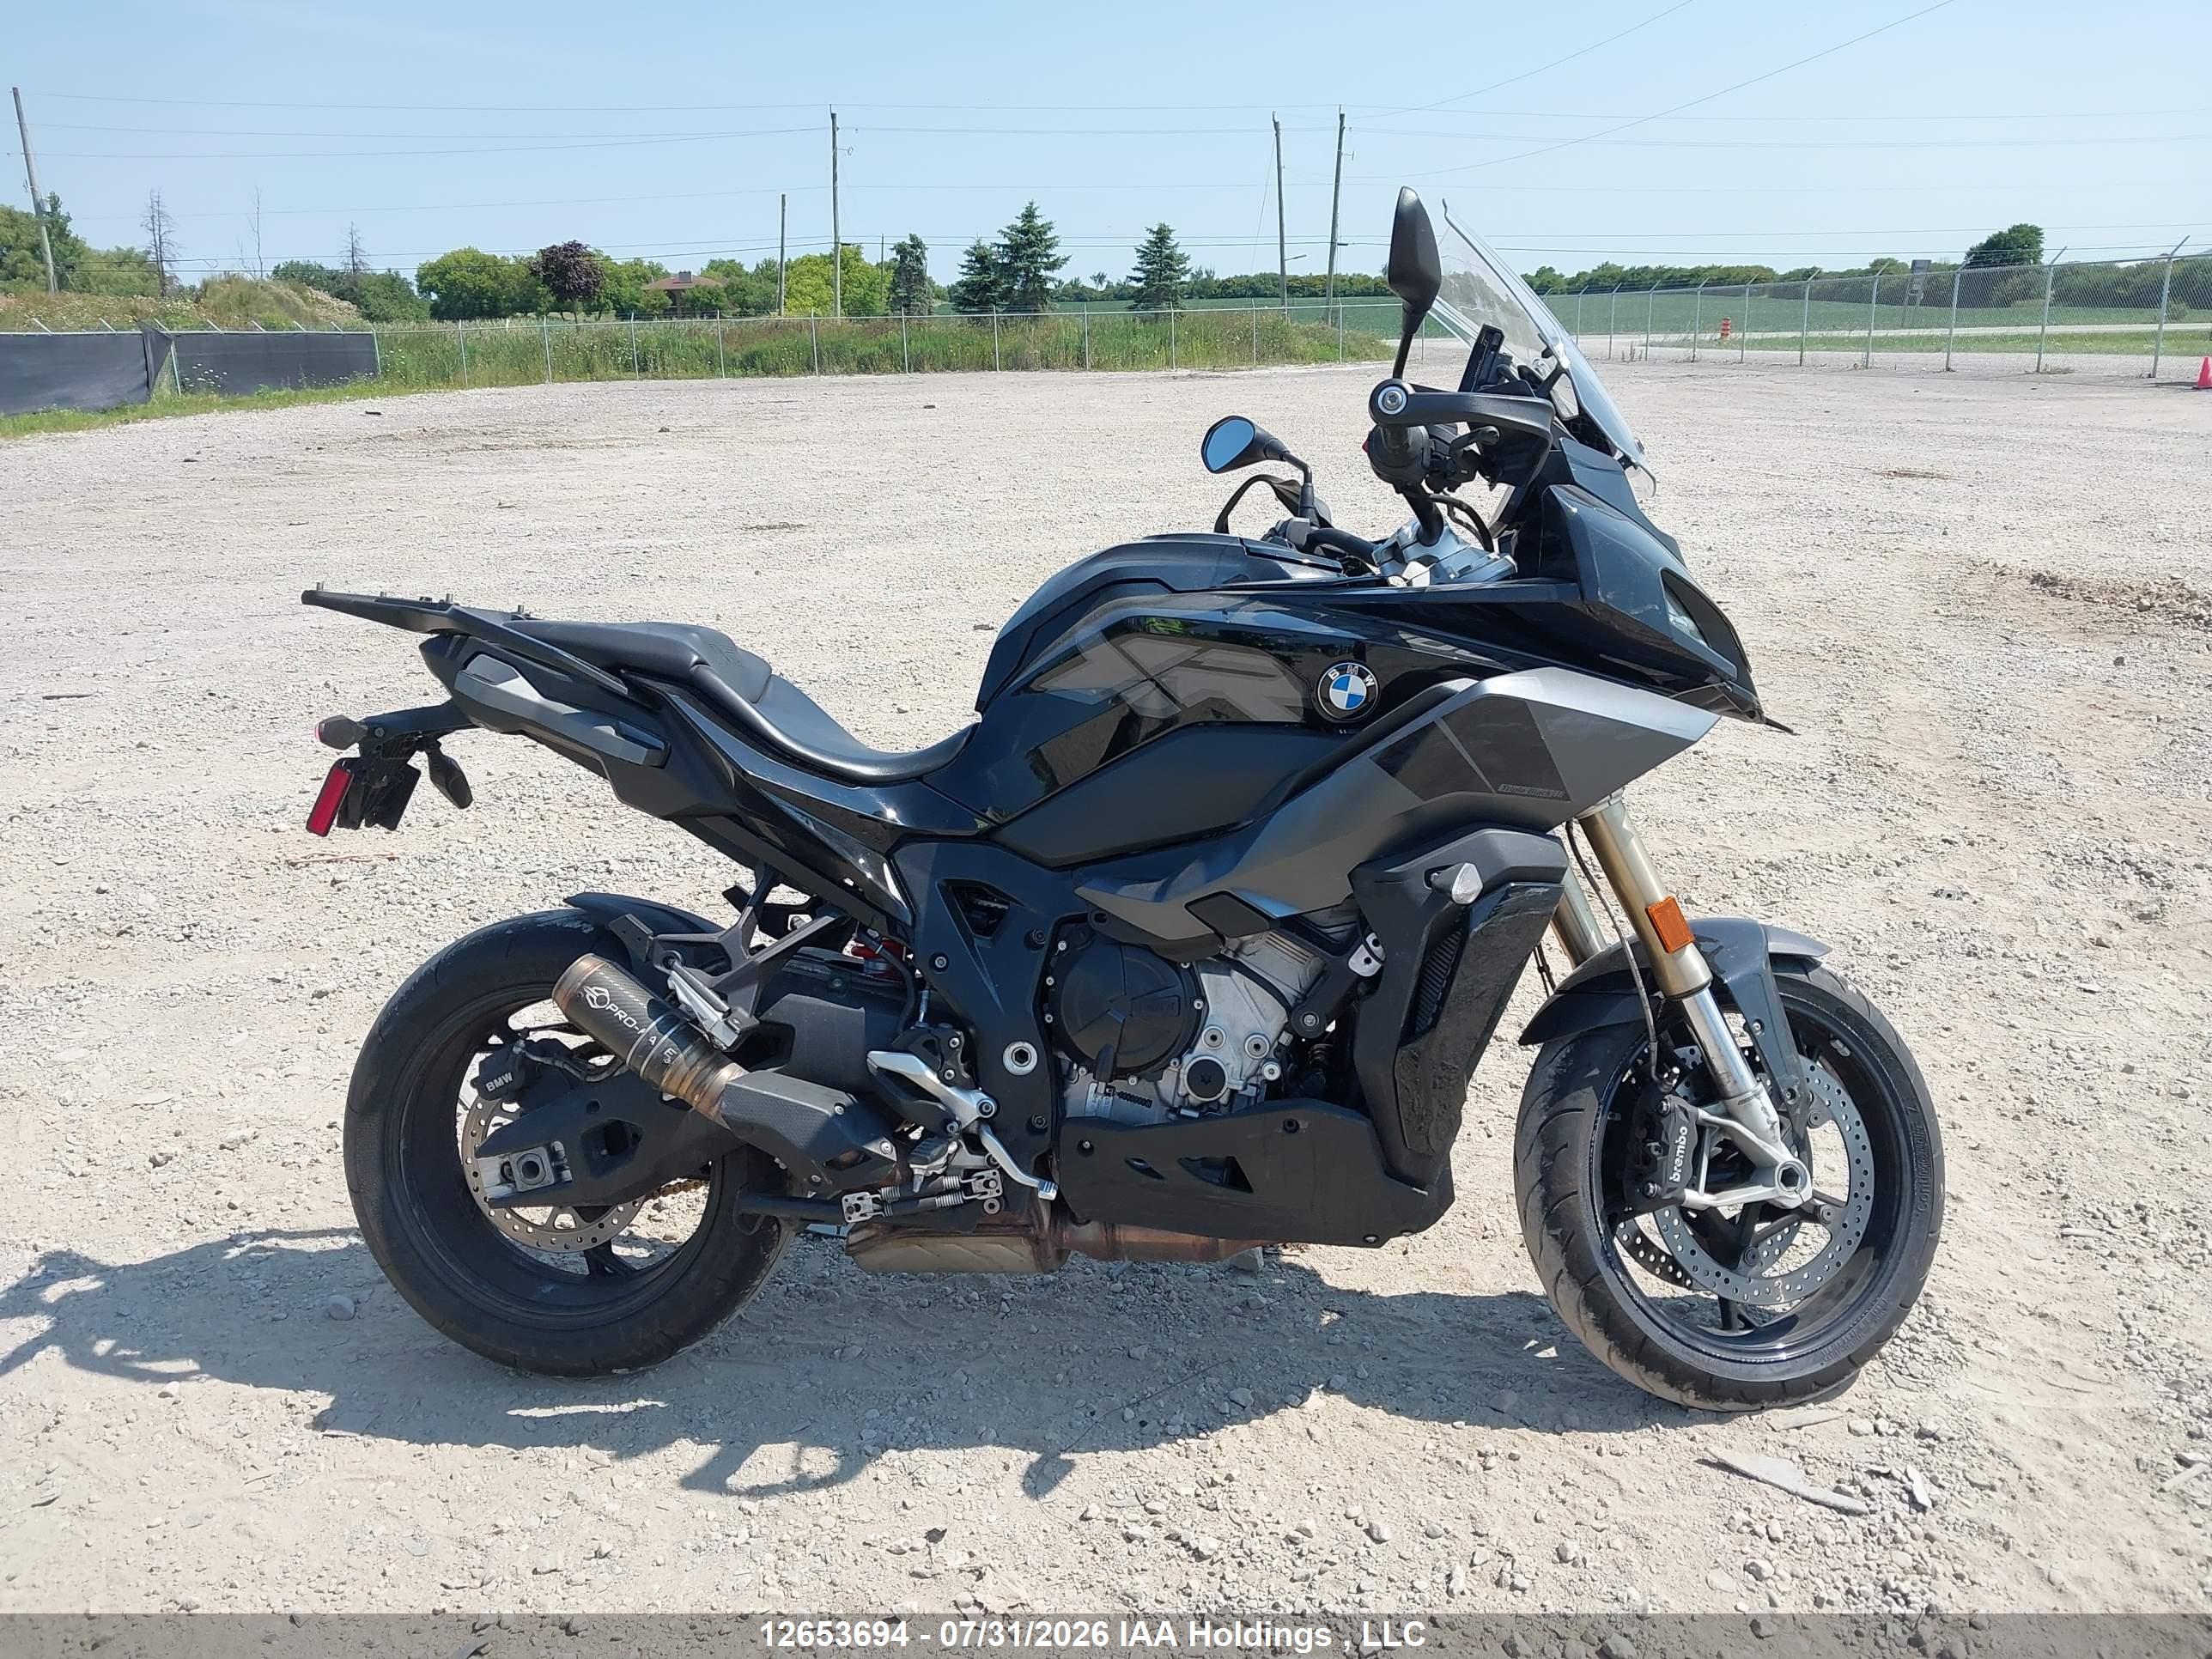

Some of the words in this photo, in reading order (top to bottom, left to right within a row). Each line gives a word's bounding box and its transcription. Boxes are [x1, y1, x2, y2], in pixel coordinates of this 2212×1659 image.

[1328, 664, 1375, 687] BMW
[1502, 784, 1526, 793] Triple
[1527, 788, 1550, 797] Black
[485, 1072, 513, 1091] BMW
[1668, 1126, 1688, 1182] brembo
